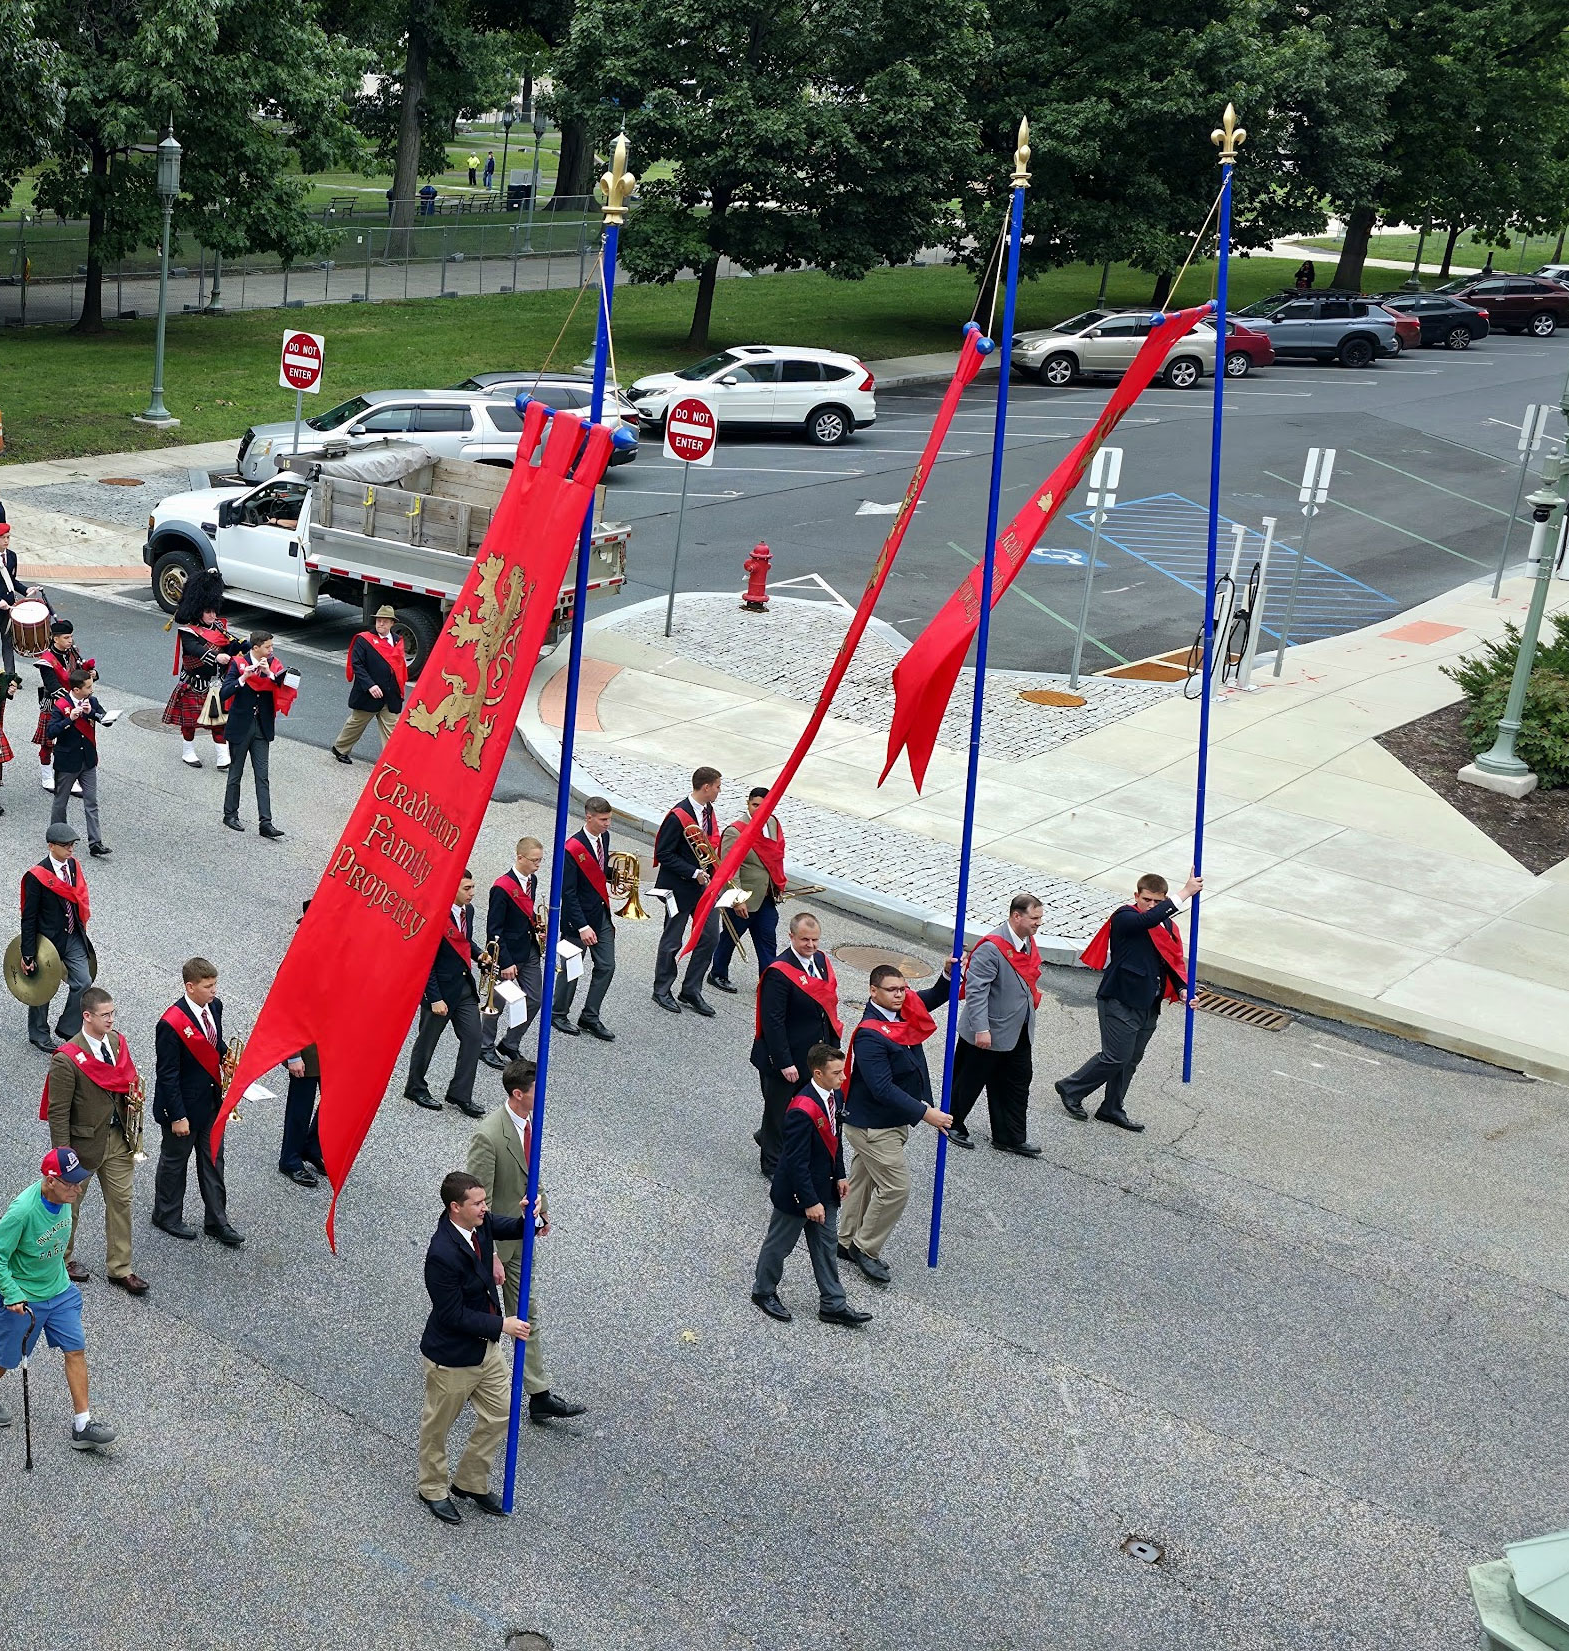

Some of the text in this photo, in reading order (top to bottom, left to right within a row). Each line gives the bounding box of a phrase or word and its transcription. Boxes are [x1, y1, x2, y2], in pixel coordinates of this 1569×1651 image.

[289, 343, 317, 356] DO NOT
[289, 368, 311, 380] ENTER
[676, 408, 710, 424] DO NOT
[676, 436, 703, 451] ENTER
[372, 762, 461, 851] Tradition
[362, 814, 433, 889] Family
